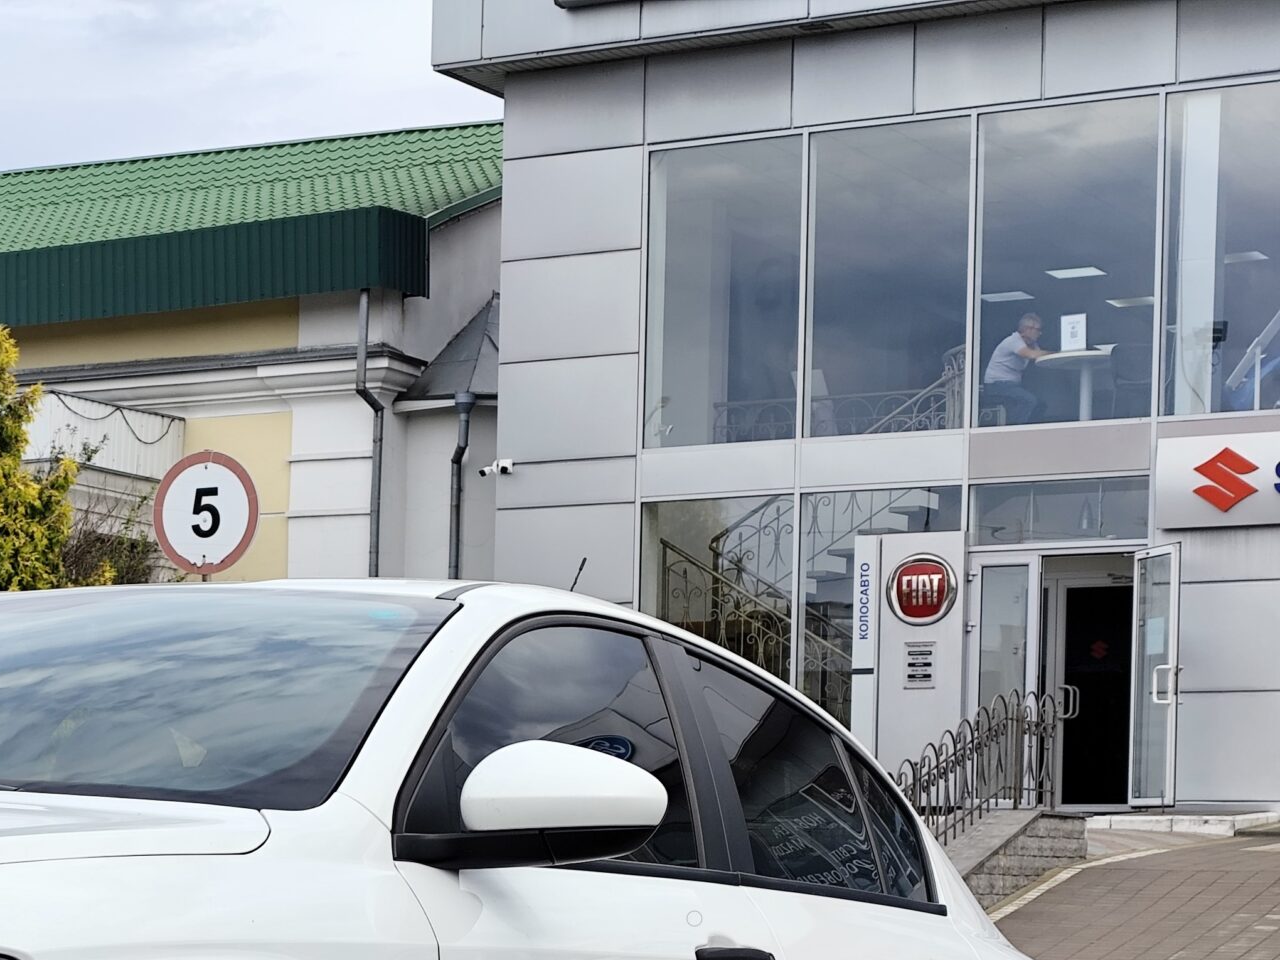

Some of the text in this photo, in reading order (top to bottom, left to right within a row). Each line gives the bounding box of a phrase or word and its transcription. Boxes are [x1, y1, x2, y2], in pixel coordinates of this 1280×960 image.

[191, 486, 221, 539] 5
[858, 562, 871, 641] КОЛОСАВТО
[901, 573, 943, 607] FIAT
